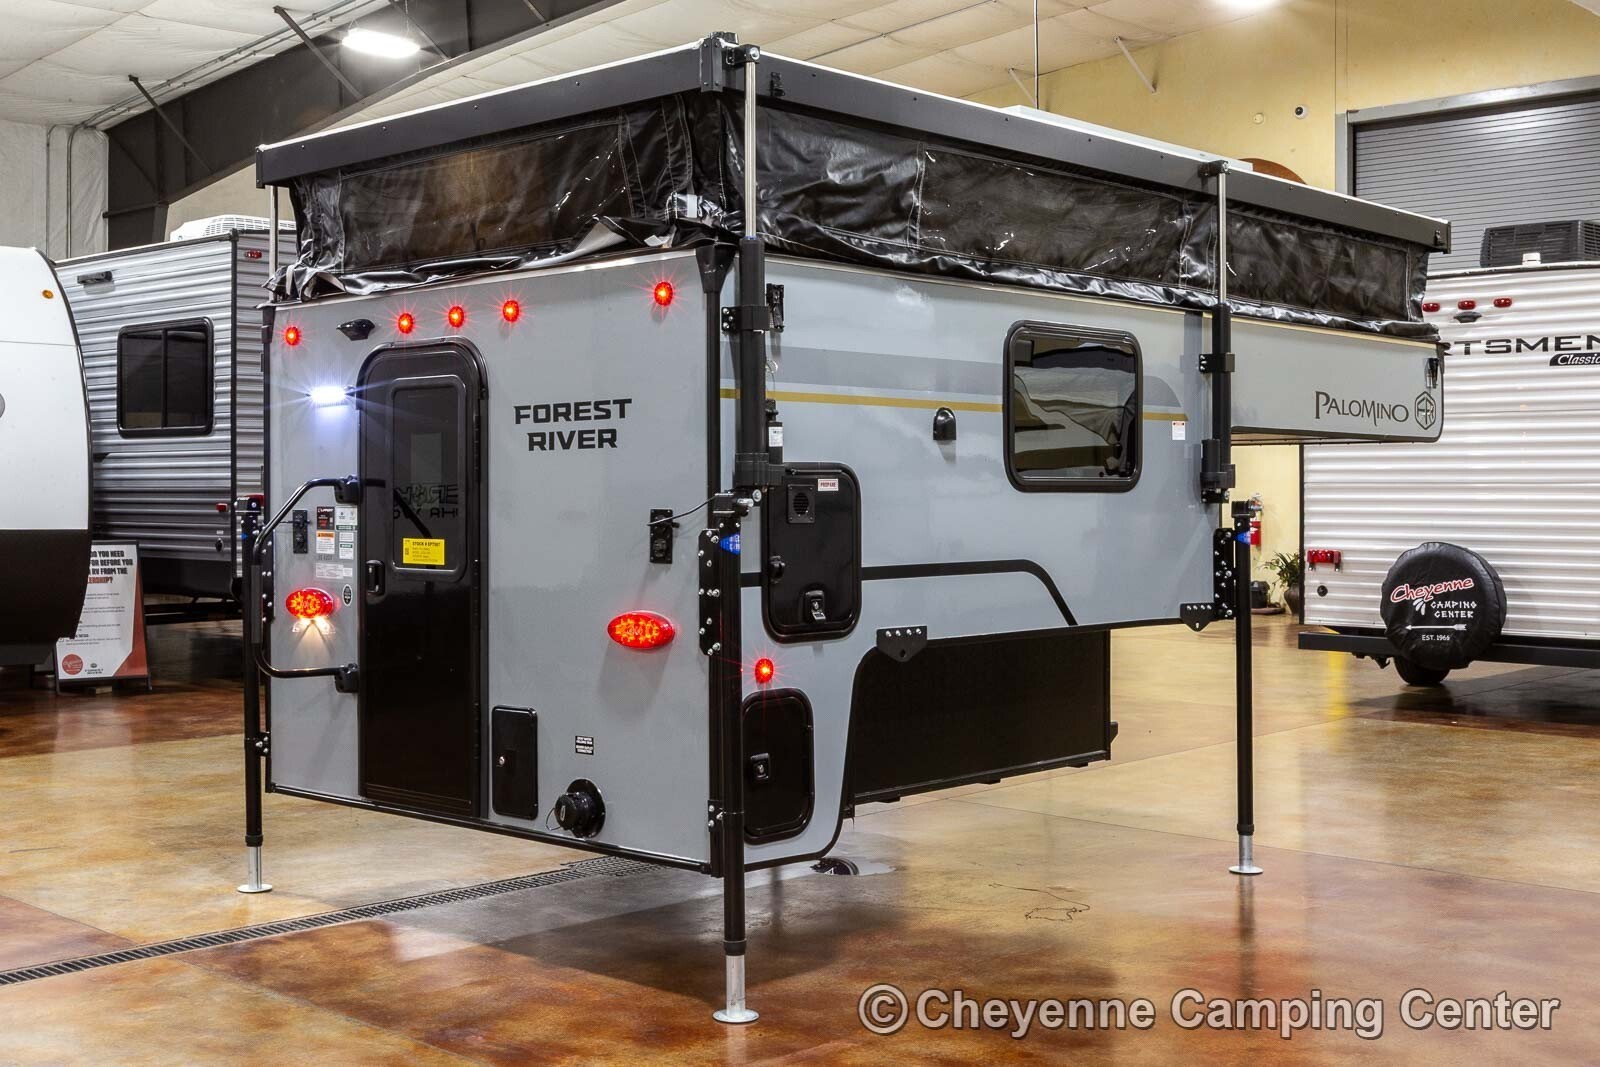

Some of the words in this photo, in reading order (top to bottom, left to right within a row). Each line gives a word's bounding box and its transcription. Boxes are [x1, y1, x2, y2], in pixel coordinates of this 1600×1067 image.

[513, 398, 632, 424] FOREST
[527, 428, 617, 451] RIVER
[100, 559, 120, 567] BEFORE
[1390, 578, 1474, 602] Cheyenne
[1430, 601, 1477, 609] CAMPING
[1434, 610, 1474, 618] CENTER
